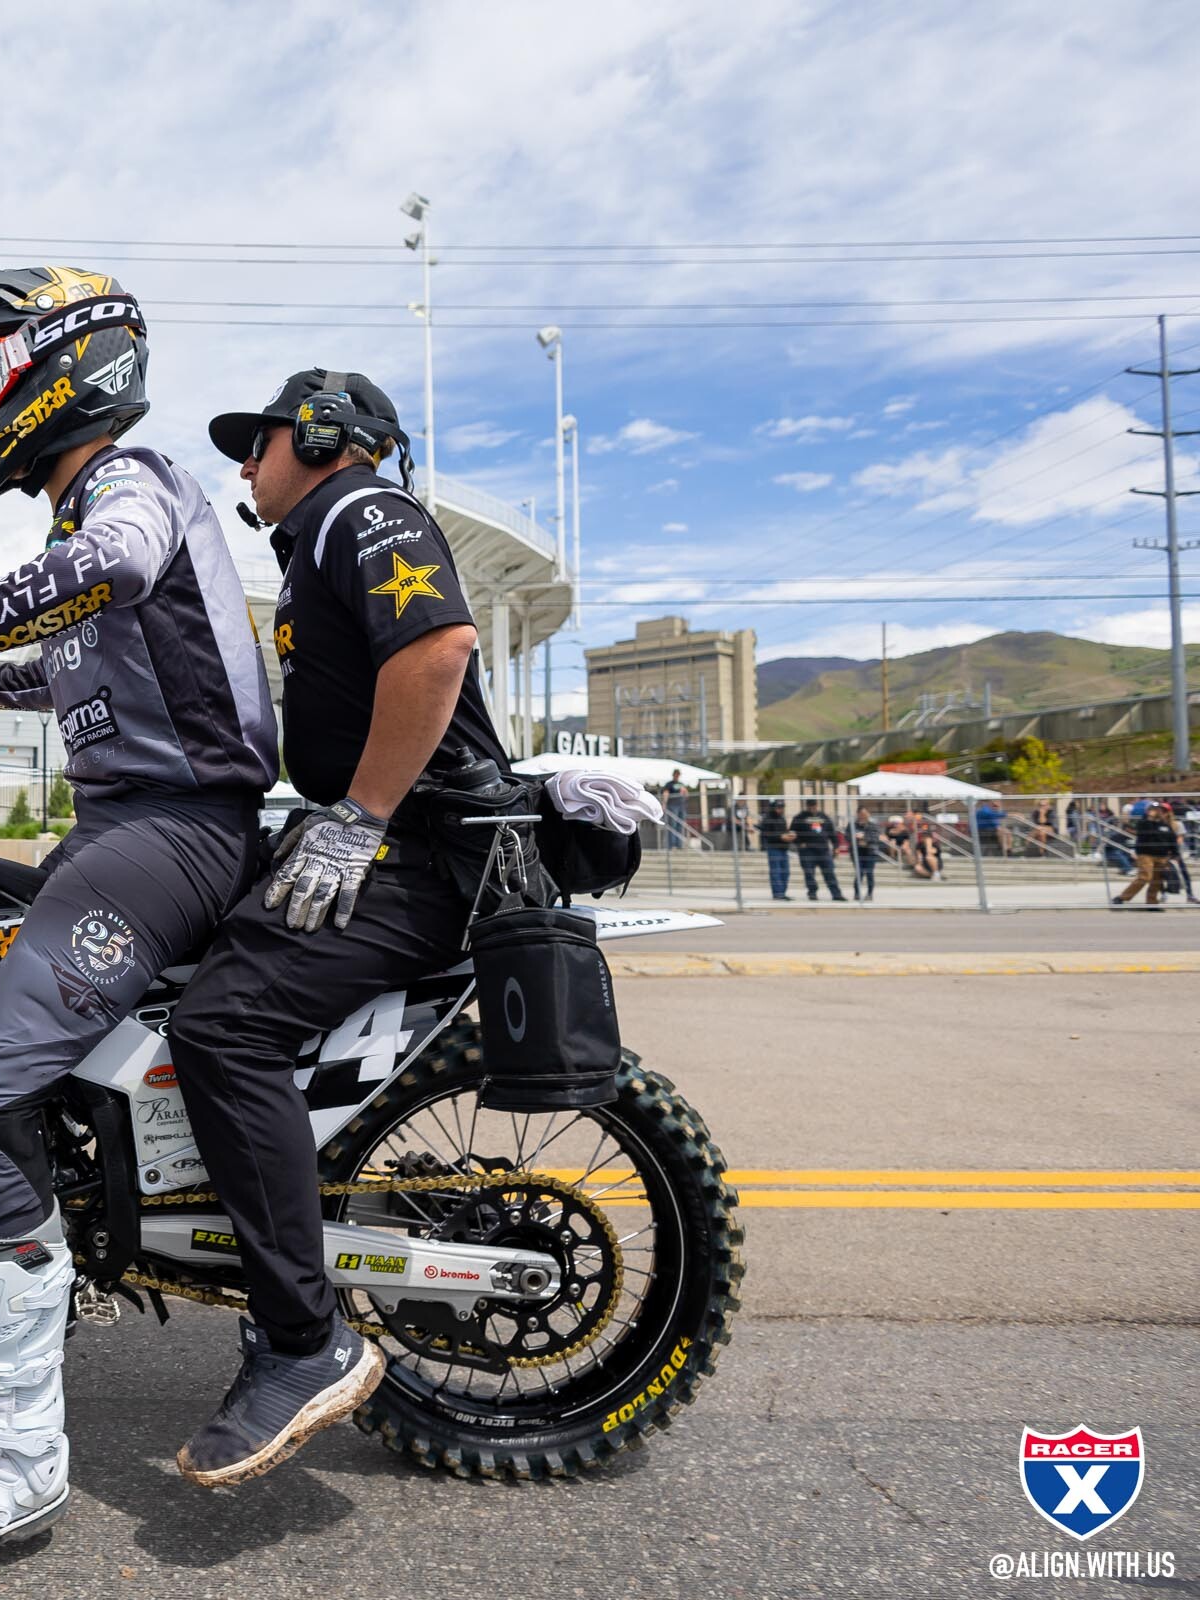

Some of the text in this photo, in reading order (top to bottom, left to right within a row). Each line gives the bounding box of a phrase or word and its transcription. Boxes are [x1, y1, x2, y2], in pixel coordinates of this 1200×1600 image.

[357, 518, 405, 541] SCOTT
[73, 531, 131, 585] FLY
[86, 724, 115, 745] RACING
[557, 731, 611, 757] GATE
[316, 825, 370, 849] Mechanix
[88, 909, 135, 942] FLY RACING
[81, 920, 130, 965] 25
[598, 960, 611, 1008] OAKLEY
[148, 1073, 170, 1084] Twin
[364, 1254, 408, 1268] HAAN
[440, 1268, 480, 1281] brembo
[602, 1344, 688, 1433] DUNLOP
[478, 1416, 516, 1428] EXCEL
